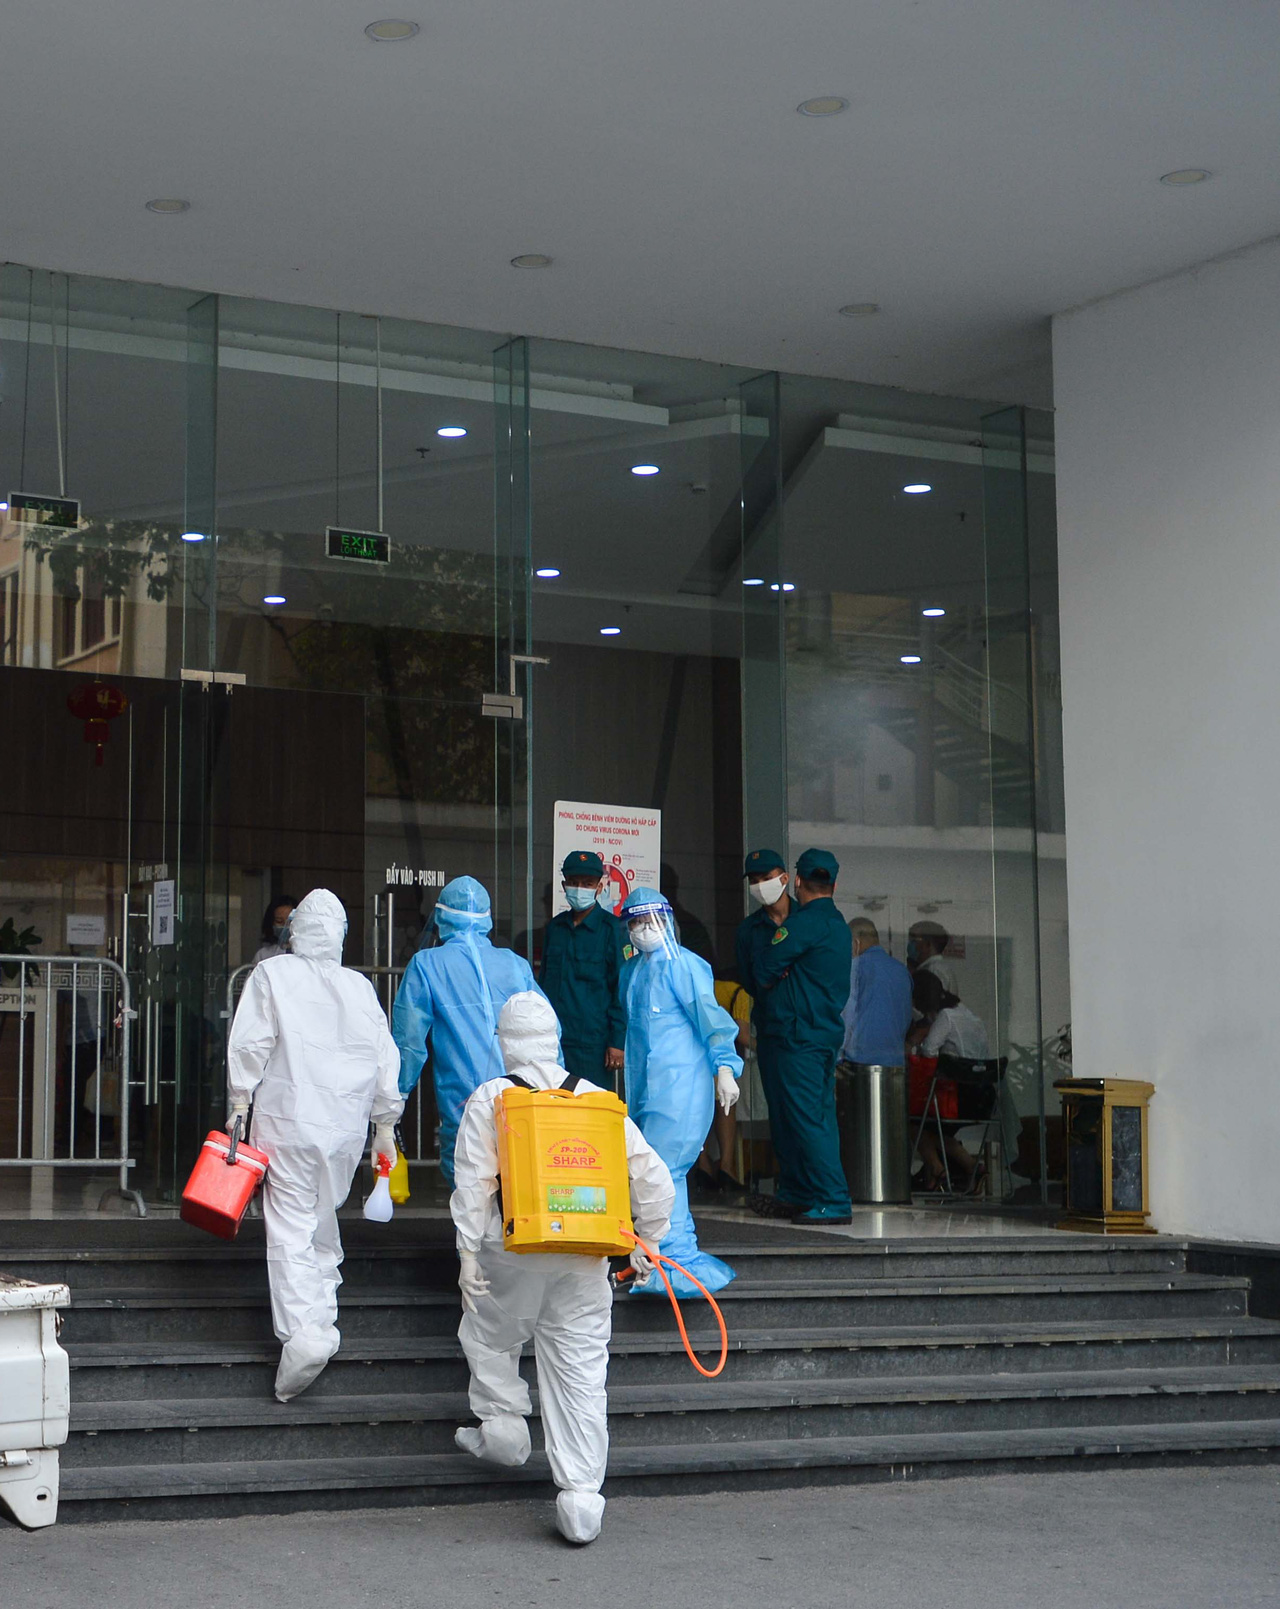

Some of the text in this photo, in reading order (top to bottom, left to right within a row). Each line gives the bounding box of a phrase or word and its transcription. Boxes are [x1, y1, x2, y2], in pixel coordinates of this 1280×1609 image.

[341, 535, 377, 549] EXIT
[386, 862, 399, 884] ĐẨY
[401, 866, 413, 885] VÀO
[419, 870, 436, 886] PUSH
[438, 871, 444, 886] IN
[553, 1156, 596, 1166] SHARP
